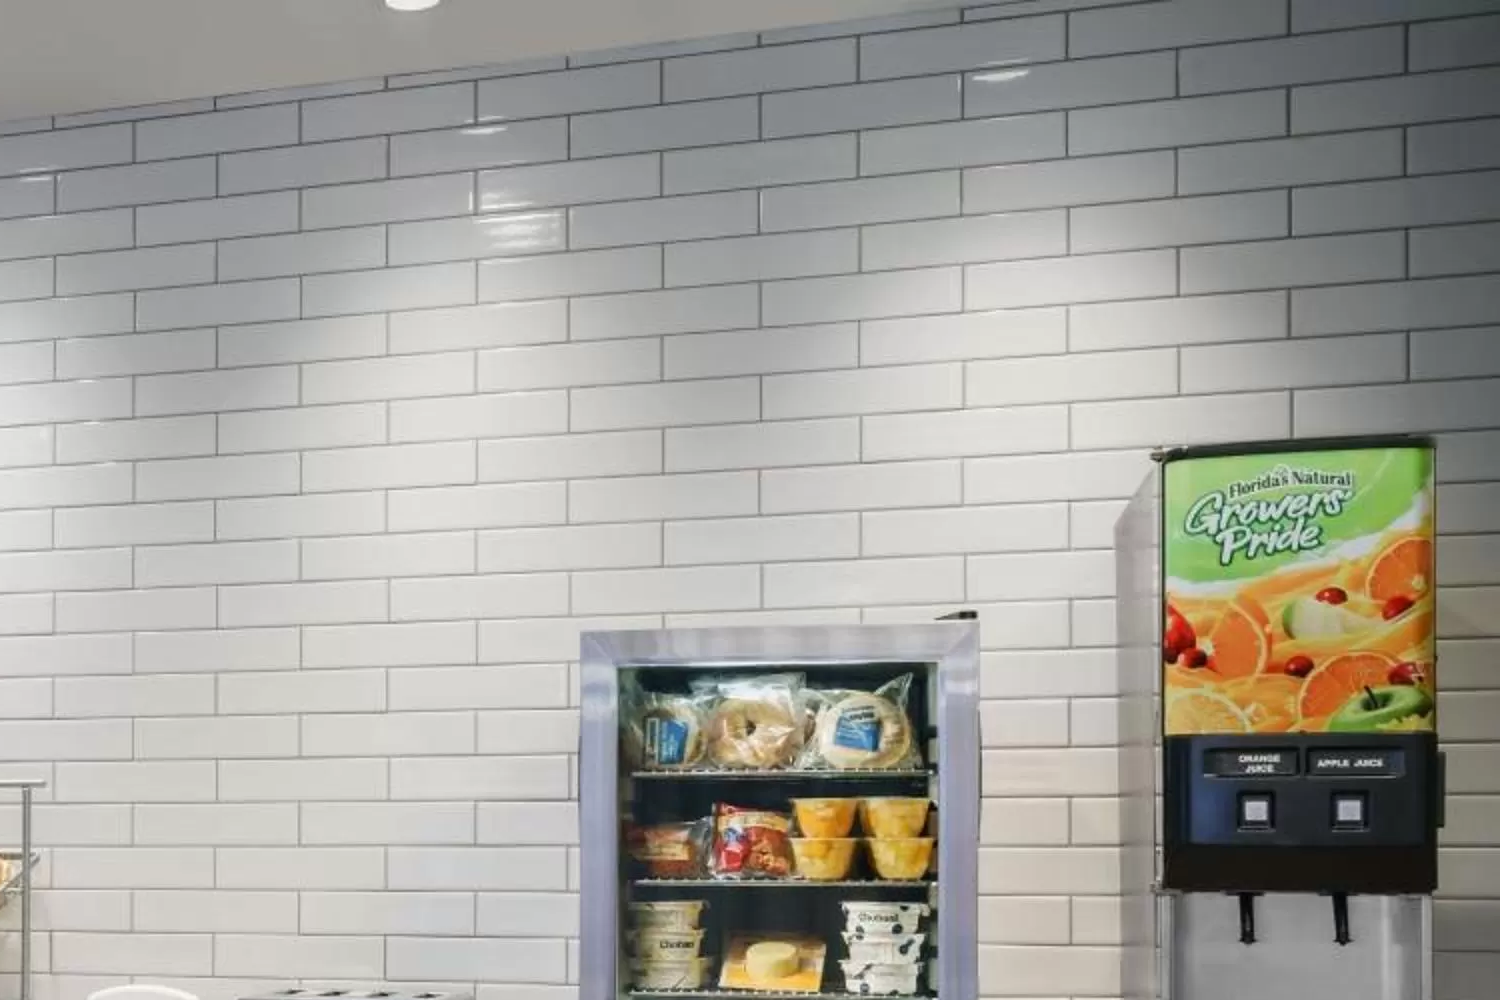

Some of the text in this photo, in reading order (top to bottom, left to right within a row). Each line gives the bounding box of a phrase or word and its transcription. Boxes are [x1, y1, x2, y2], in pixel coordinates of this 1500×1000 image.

[1291, 470, 1352, 487] Natural
[1214, 516, 1323, 566] Pride
[1238, 754, 1281, 763] ORANGE
[1317, 758, 1384, 768] APPLE JUICE
[1245, 764, 1275, 774] JUICE
